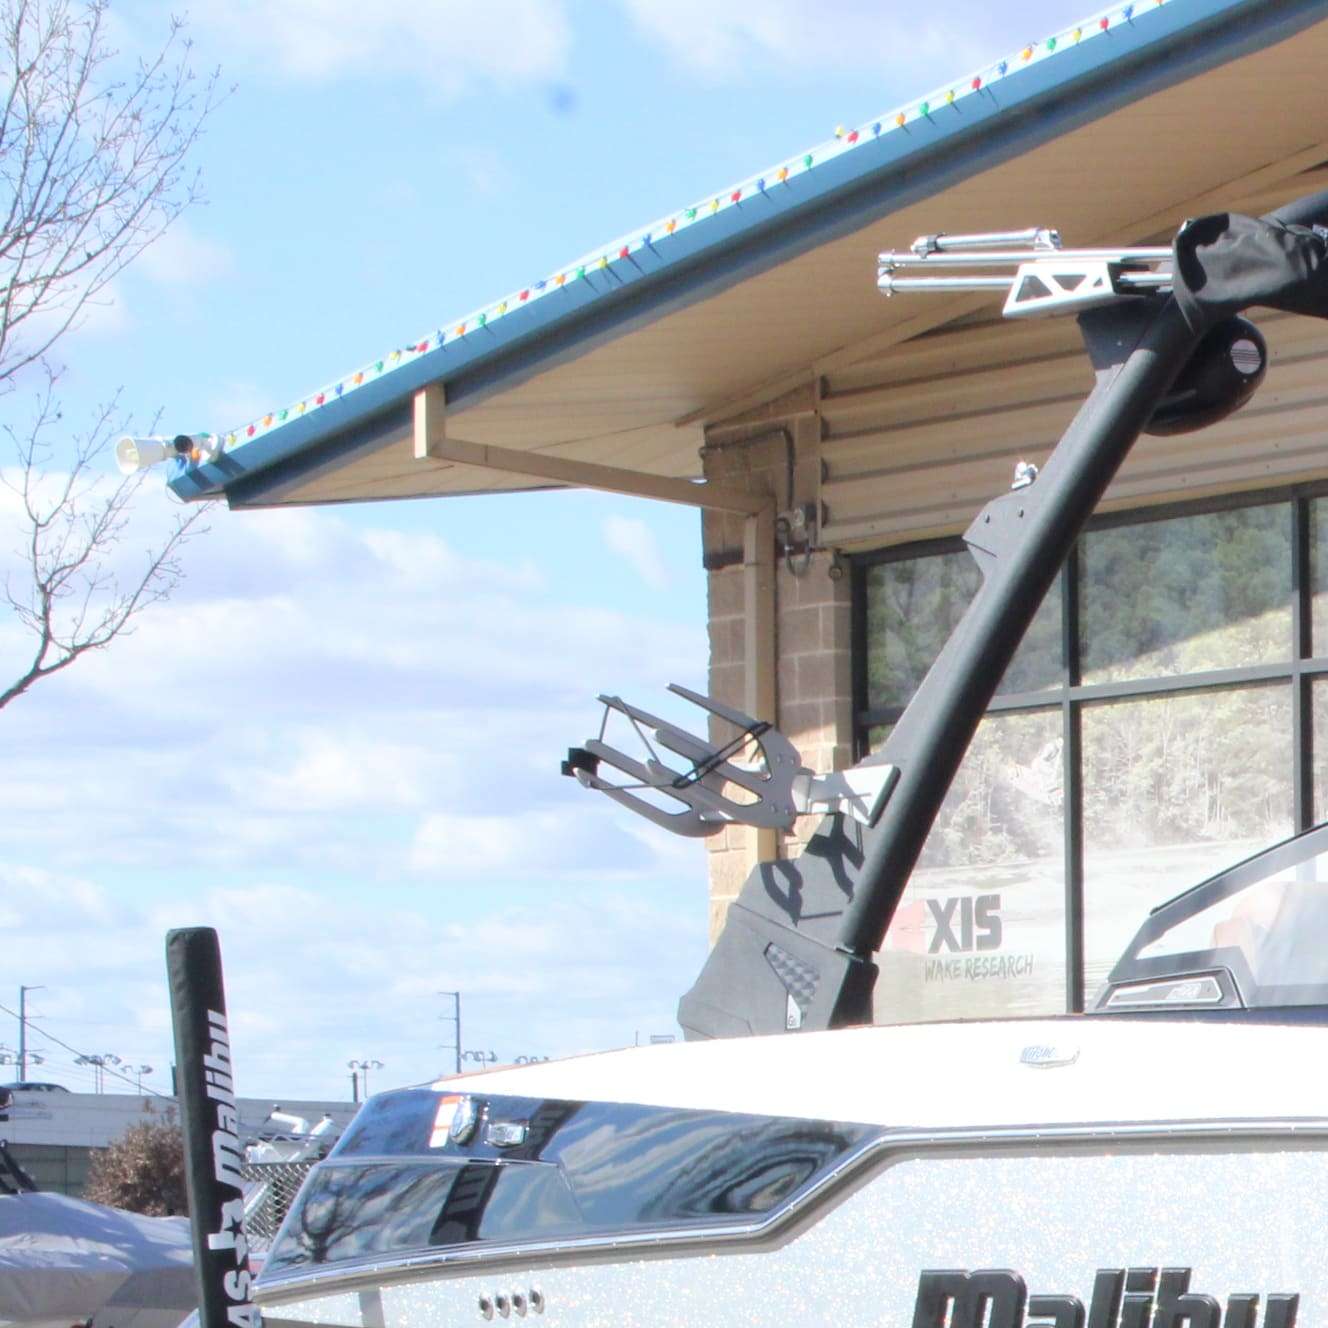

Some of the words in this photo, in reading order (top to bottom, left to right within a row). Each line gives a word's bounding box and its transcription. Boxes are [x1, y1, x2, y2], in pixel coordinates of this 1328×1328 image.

[924, 959, 962, 984] WAKE
[964, 954, 1034, 981] RESEARCH
[203, 1009, 244, 1191] Malibu
